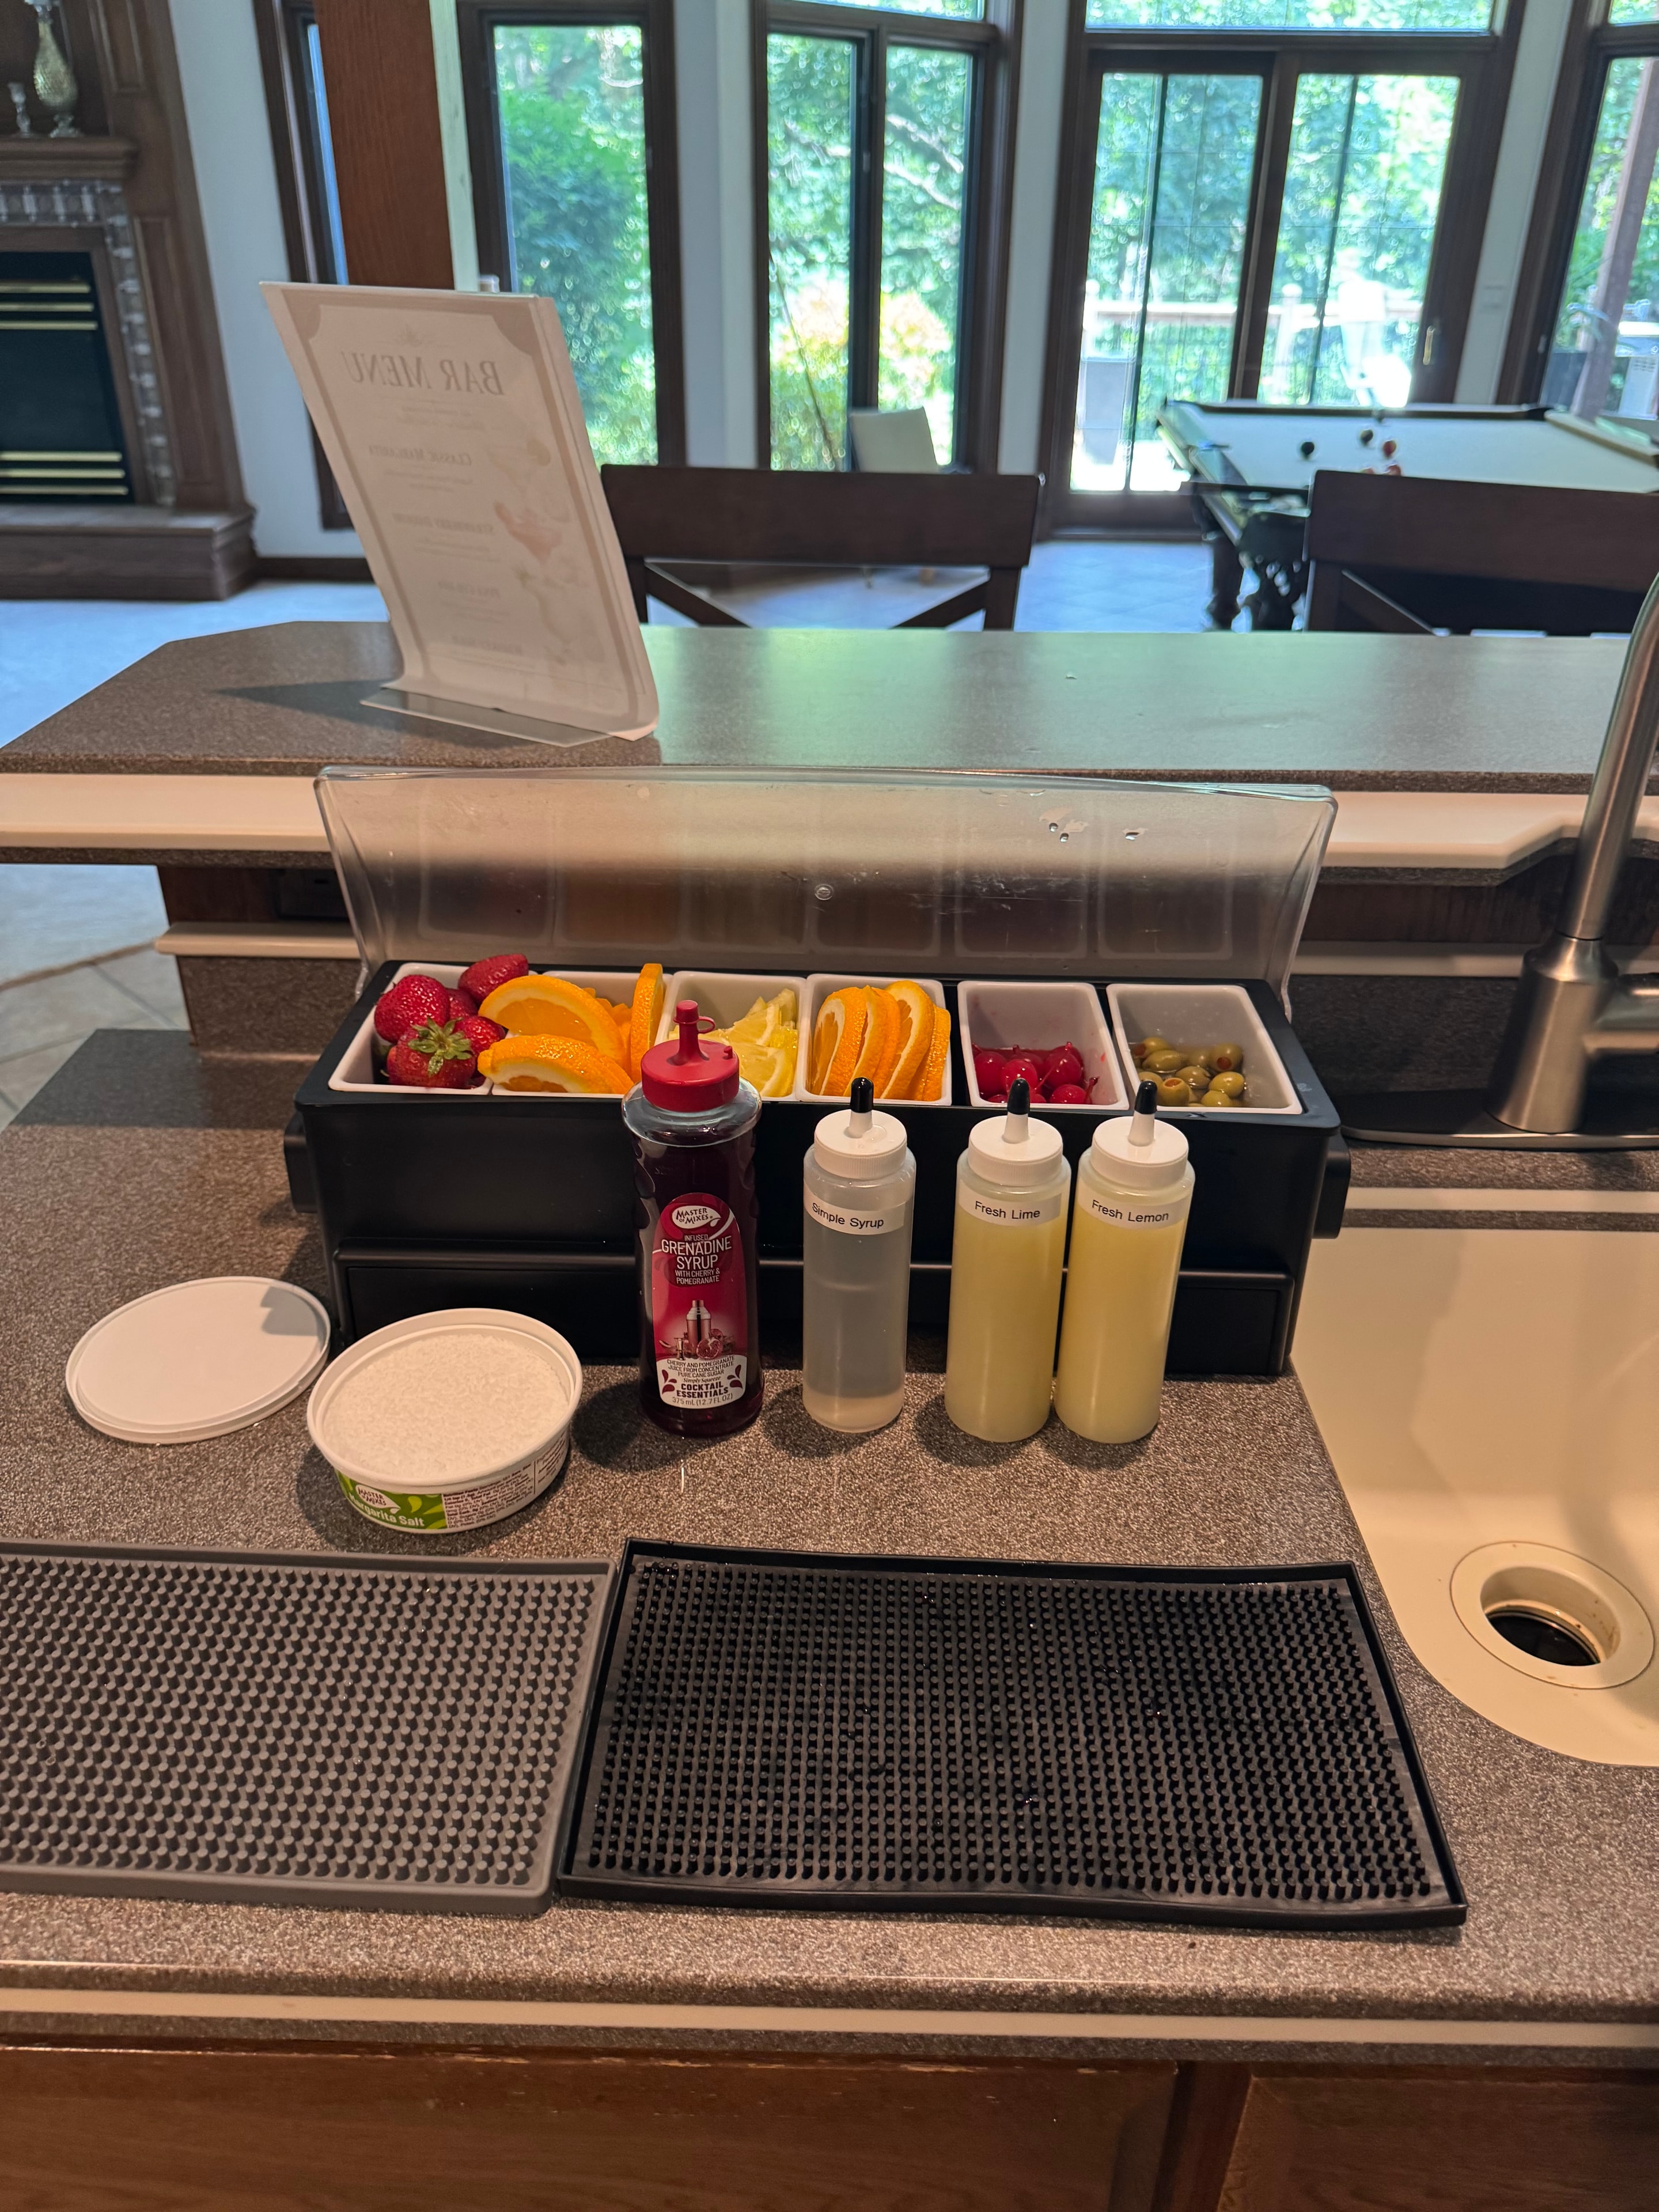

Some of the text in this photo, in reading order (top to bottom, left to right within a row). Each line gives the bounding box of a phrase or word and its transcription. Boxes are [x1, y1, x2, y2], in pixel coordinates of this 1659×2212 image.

[676, 1207, 707, 1220] MASTER
[812, 1202, 884, 1229] Simple Syrup
[975, 1200, 1040, 1219] Fresh Lime
[1092, 1199, 1169, 1222] Fresh Lemon
[685, 1214, 709, 1224] MIXES
[661, 1236, 732, 1256] GRENADINE
[676, 1255, 718, 1270] SYRUP
[675, 1270, 691, 1278] WITH
[691, 1268, 715, 1278] CHERRY
[676, 1275, 719, 1285] POMEGRANATE
[698, 1361, 734, 1373] CONCENTRATE
[699, 1355, 734, 1368] POMEGRANATE
[707, 1369, 724, 1377] SUGAR
[681, 1381, 724, 1391] COCKTAIL
[672, 1396, 684, 1404] 375
[696, 1398, 713, 1406] (12.7
[722, 1393, 733, 1401] OZ)
[676, 1387, 729, 1399] ESSENTIALS
[358, 1486, 384, 1500] MASTER
[349, 1492, 425, 1527] Margarita Salt
